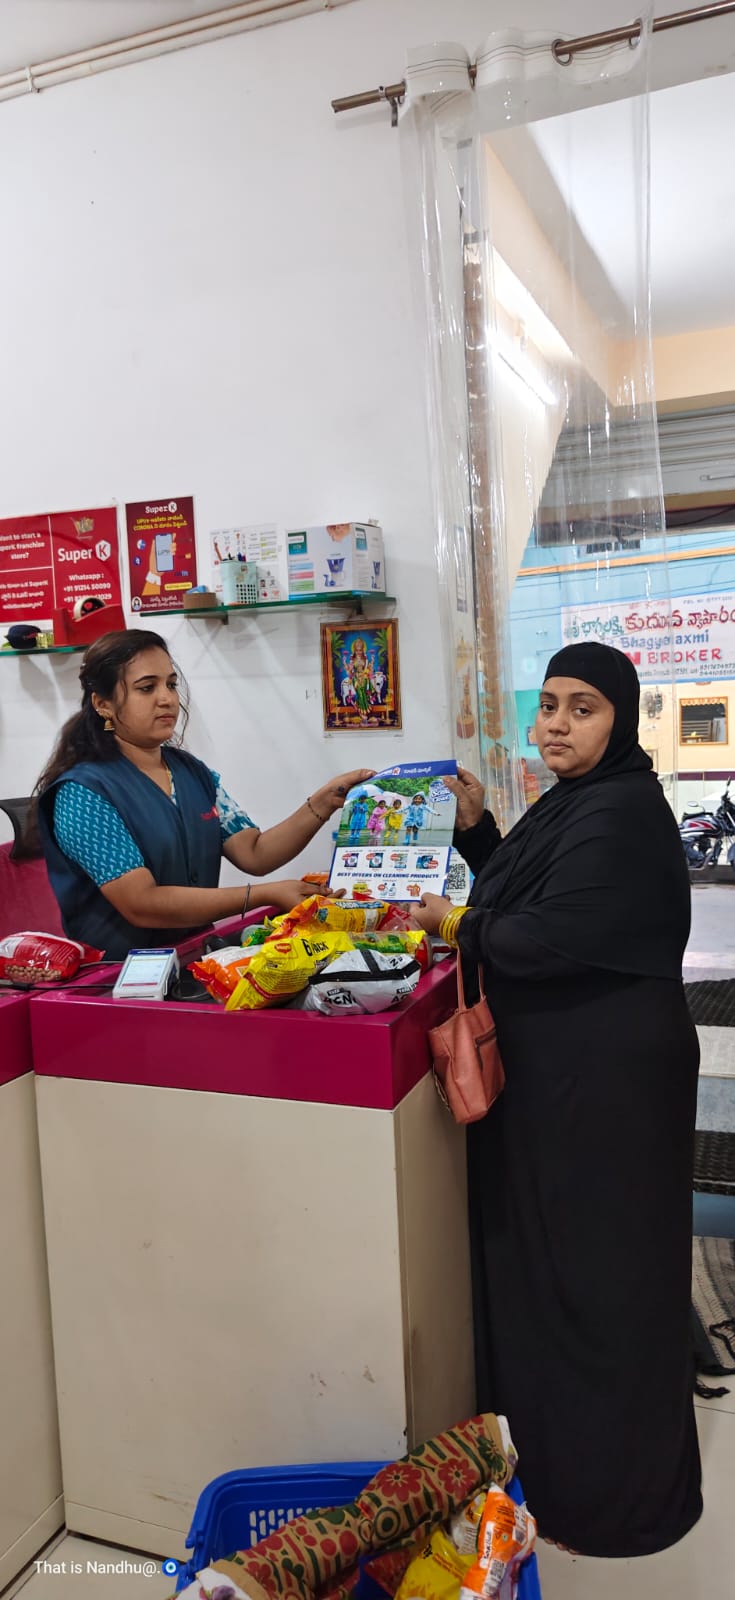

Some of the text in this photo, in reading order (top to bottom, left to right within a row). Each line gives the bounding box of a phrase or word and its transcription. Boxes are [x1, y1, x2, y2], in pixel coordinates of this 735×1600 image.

[10, 552, 29, 560] store?
[58, 548, 92, 564] Super
[647, 648, 721, 664] BROKER
[301, 939, 312, 957] 6
